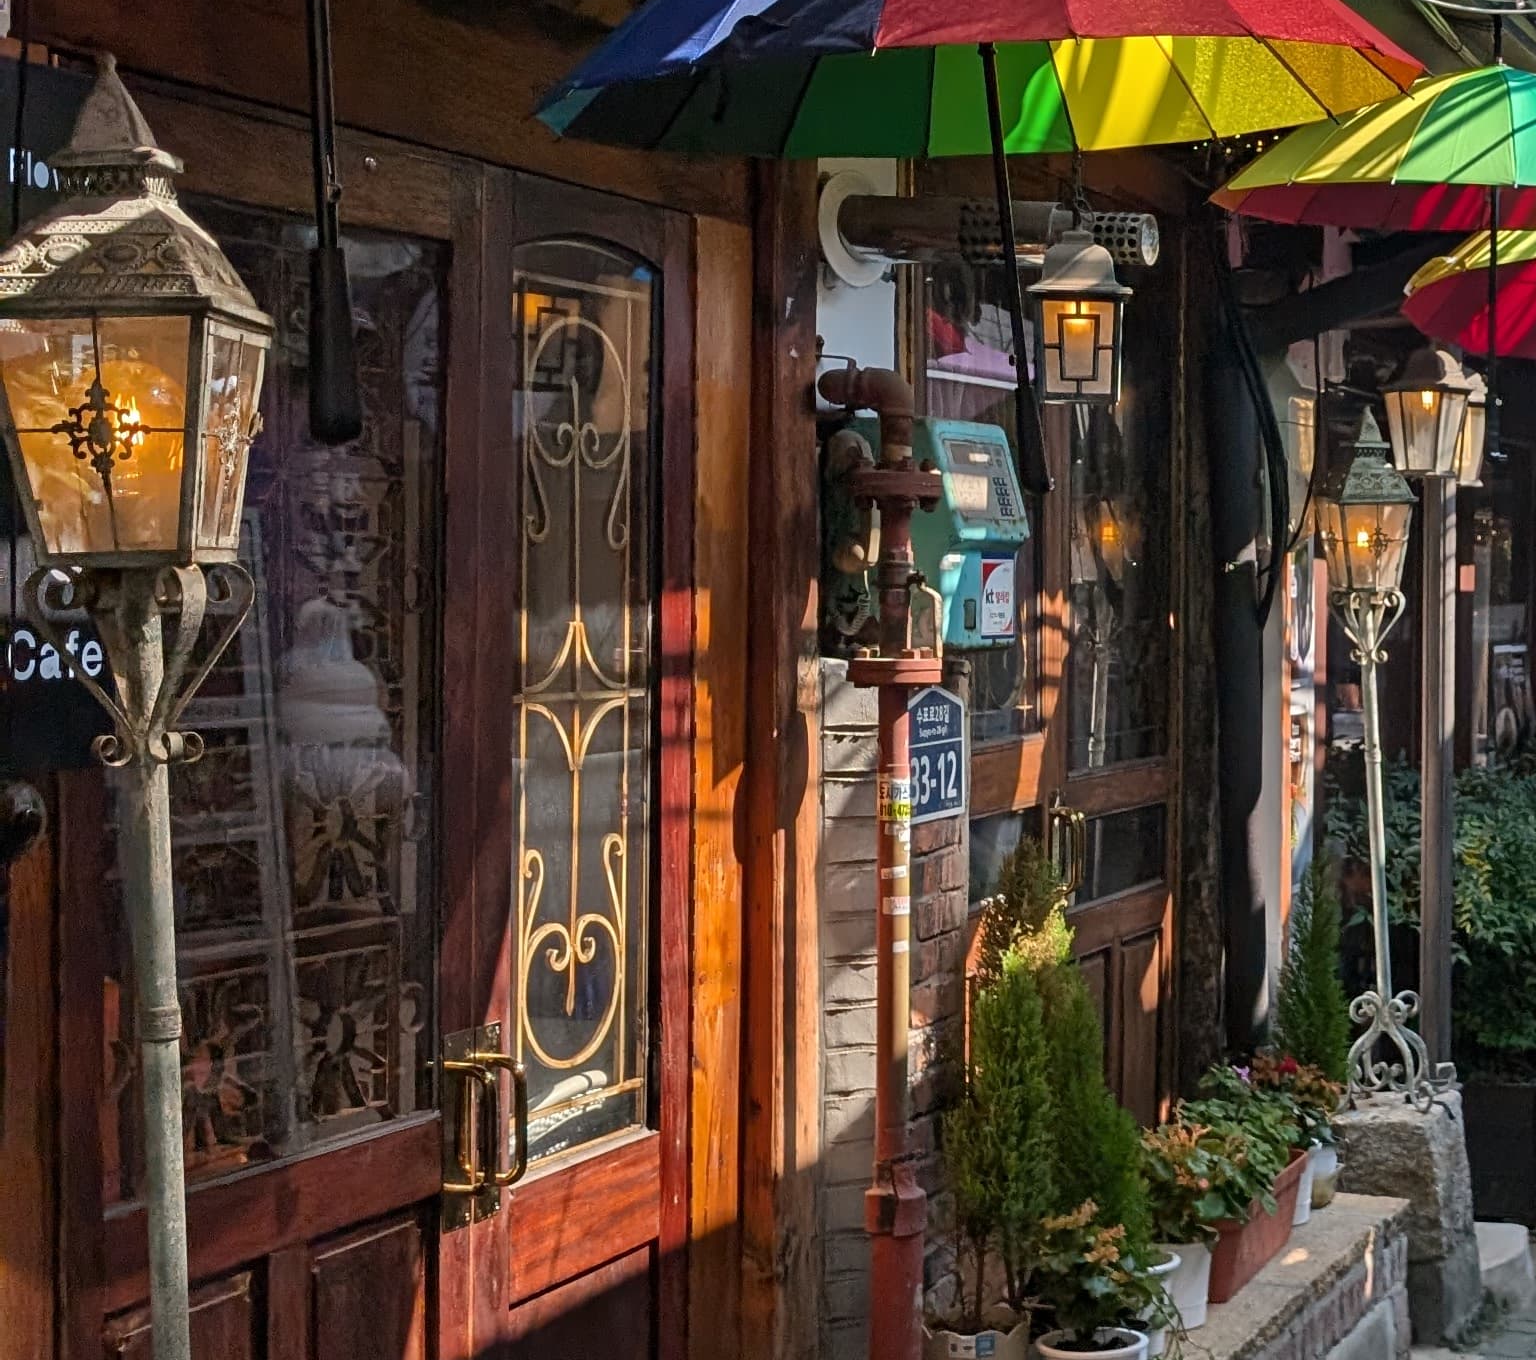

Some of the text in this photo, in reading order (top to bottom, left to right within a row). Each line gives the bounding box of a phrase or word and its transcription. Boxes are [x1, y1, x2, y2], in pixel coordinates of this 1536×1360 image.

[985, 588, 995, 605] kt
[7, 629, 103, 681] Cafe
[916, 704, 950, 726] 수표로28길
[910, 750, 957, 807] 33-12
